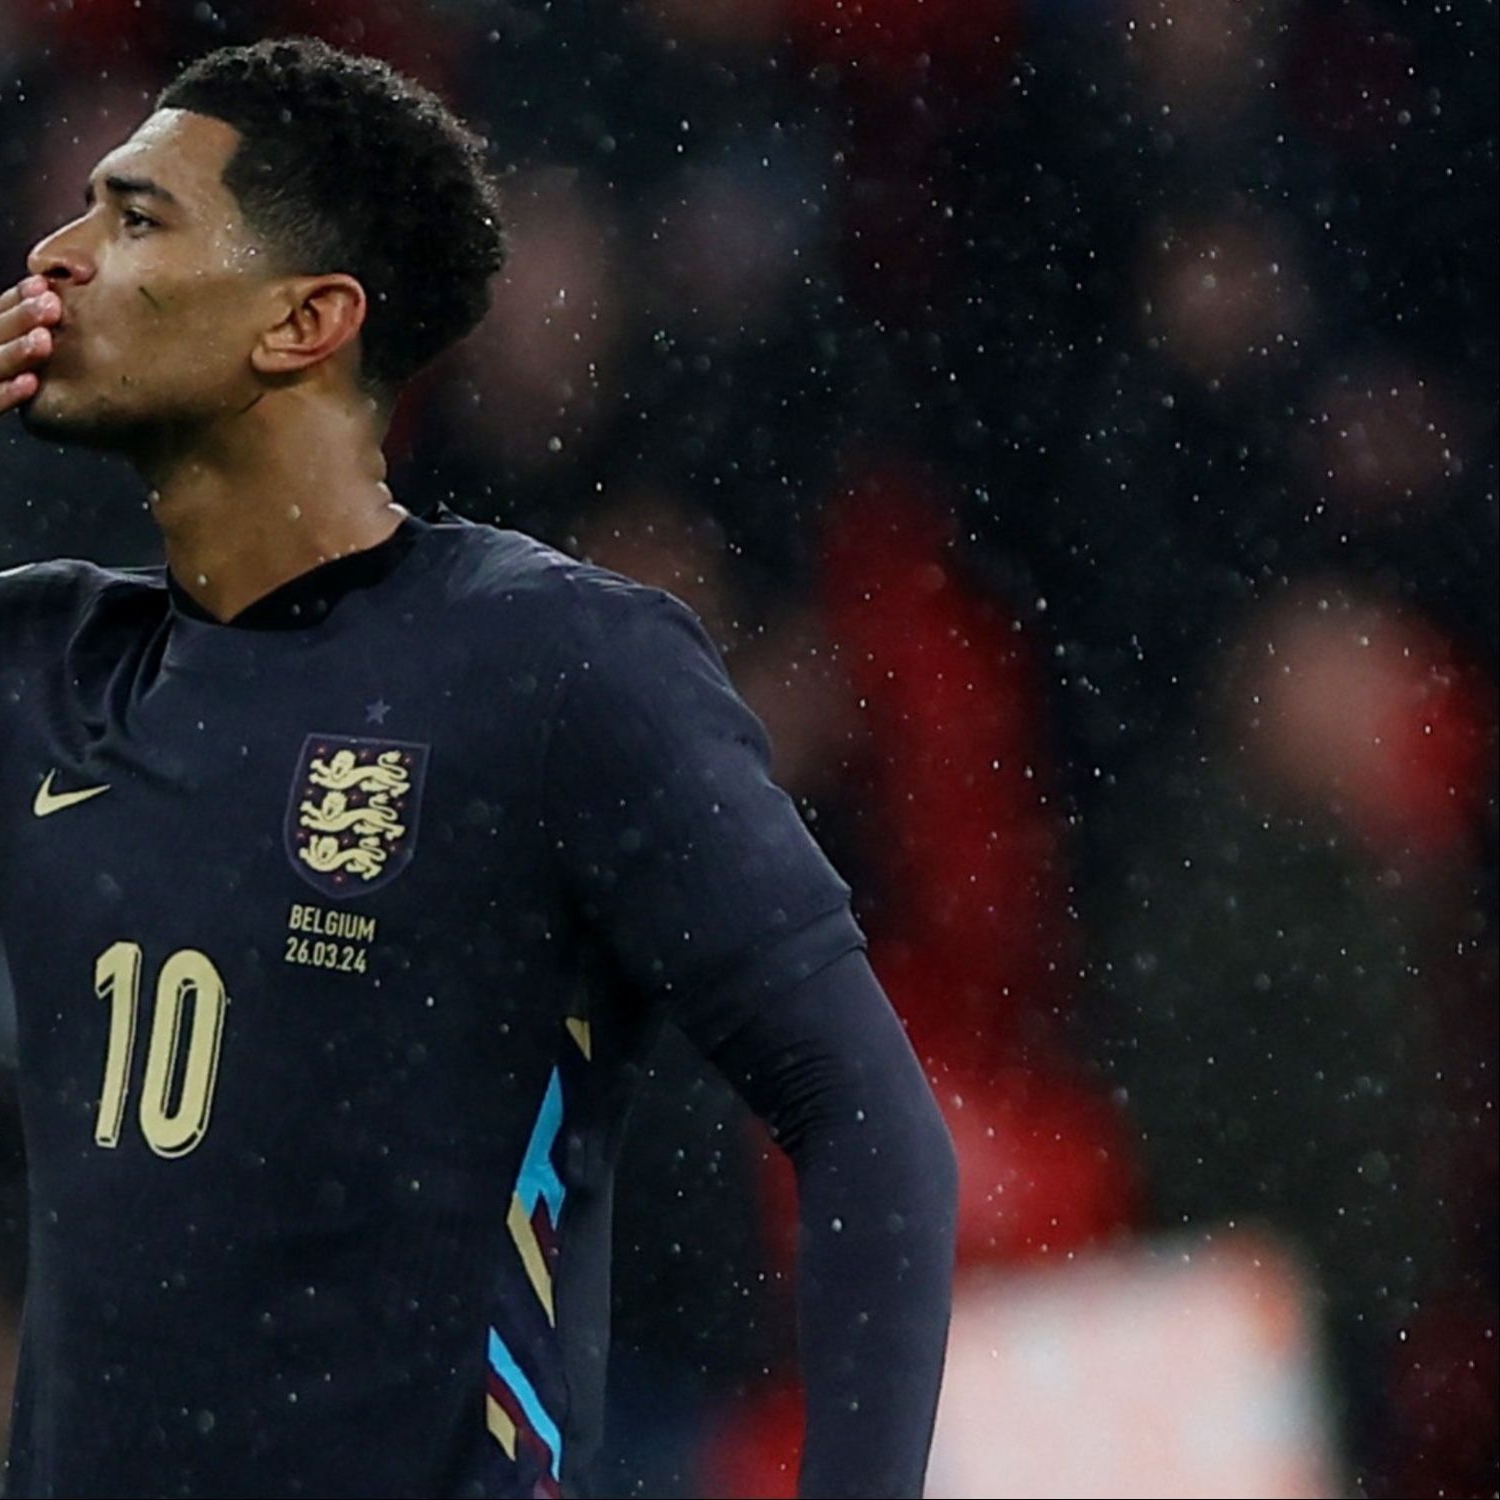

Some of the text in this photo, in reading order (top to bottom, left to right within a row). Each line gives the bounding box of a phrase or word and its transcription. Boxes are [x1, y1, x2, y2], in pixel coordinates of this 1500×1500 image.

[289, 904, 376, 943] BELGIUM
[284, 936, 367, 974] 26.03.24
[95, 941, 226, 1159] 10
